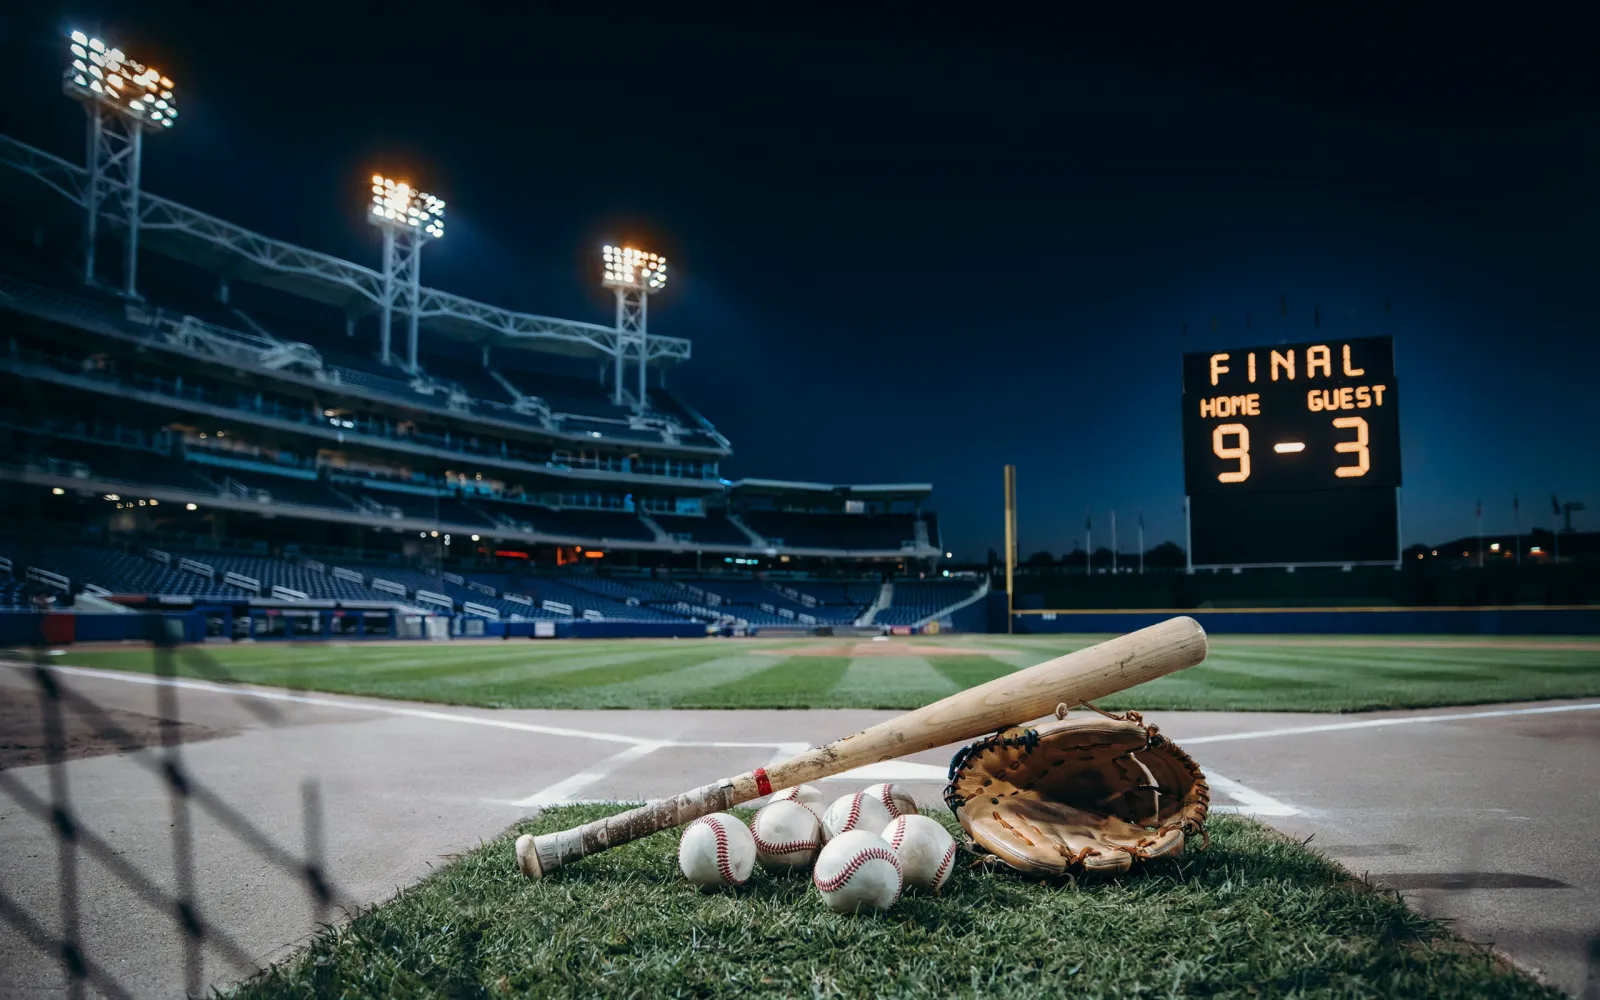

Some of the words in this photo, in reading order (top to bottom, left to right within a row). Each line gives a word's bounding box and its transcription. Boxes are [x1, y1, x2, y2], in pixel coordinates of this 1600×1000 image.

[1209, 344, 1365, 386] FINAL
[1200, 393, 1261, 418] HOME
[1307, 385, 1386, 412] GUEST
[1212, 423, 1251, 484] 9
[1332, 416, 1370, 478] 3
